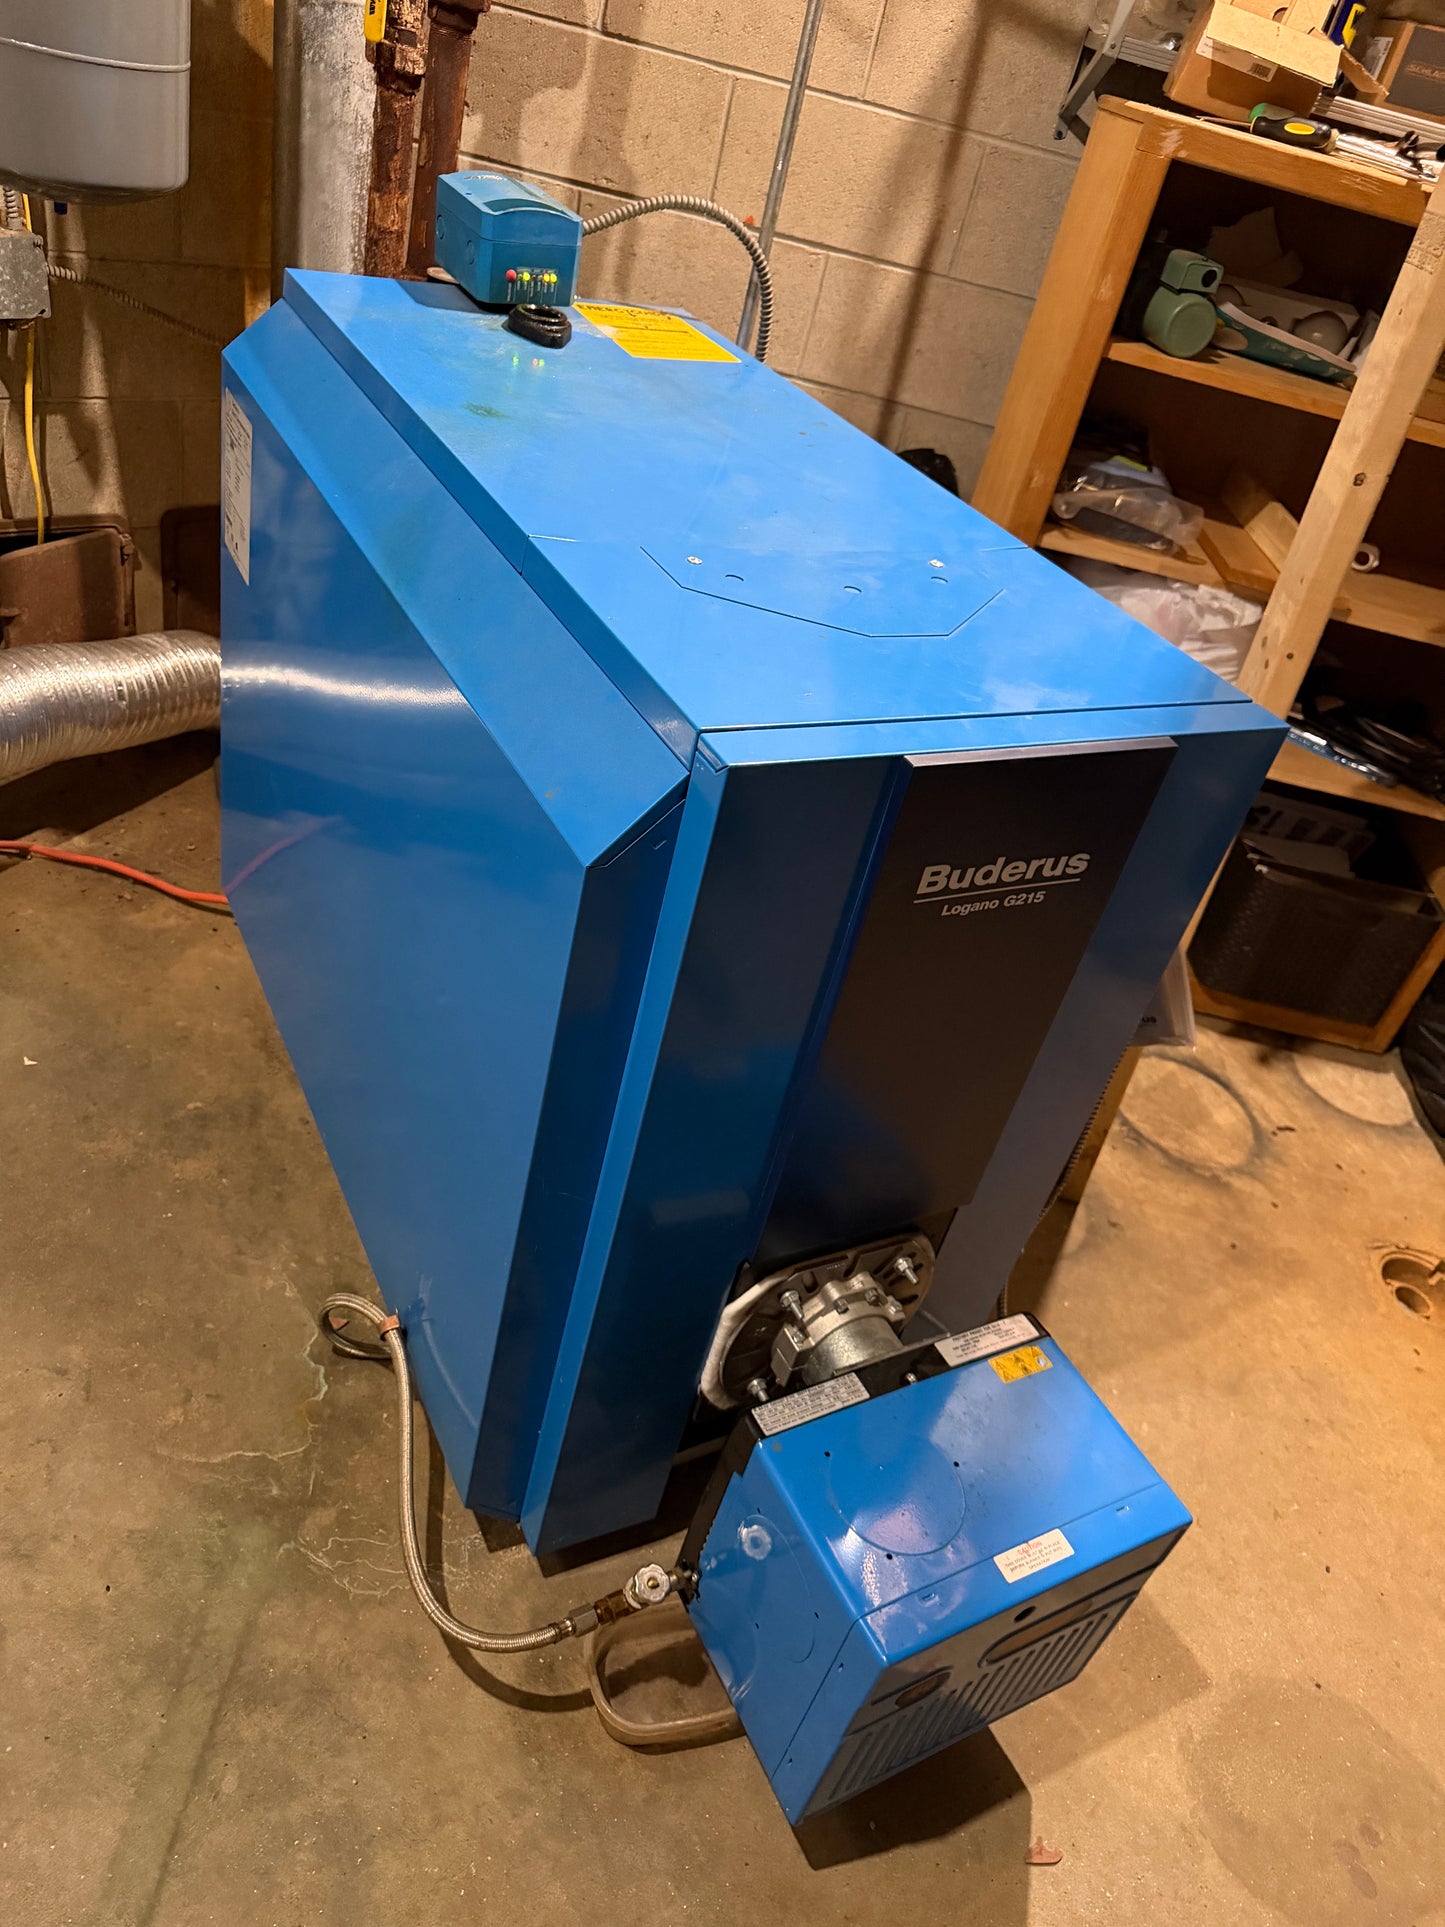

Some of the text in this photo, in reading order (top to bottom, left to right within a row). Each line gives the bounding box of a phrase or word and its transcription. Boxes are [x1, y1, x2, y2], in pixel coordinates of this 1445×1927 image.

[916, 853, 1091, 895] Buderus
[941, 891, 1047, 917] Logano G215
